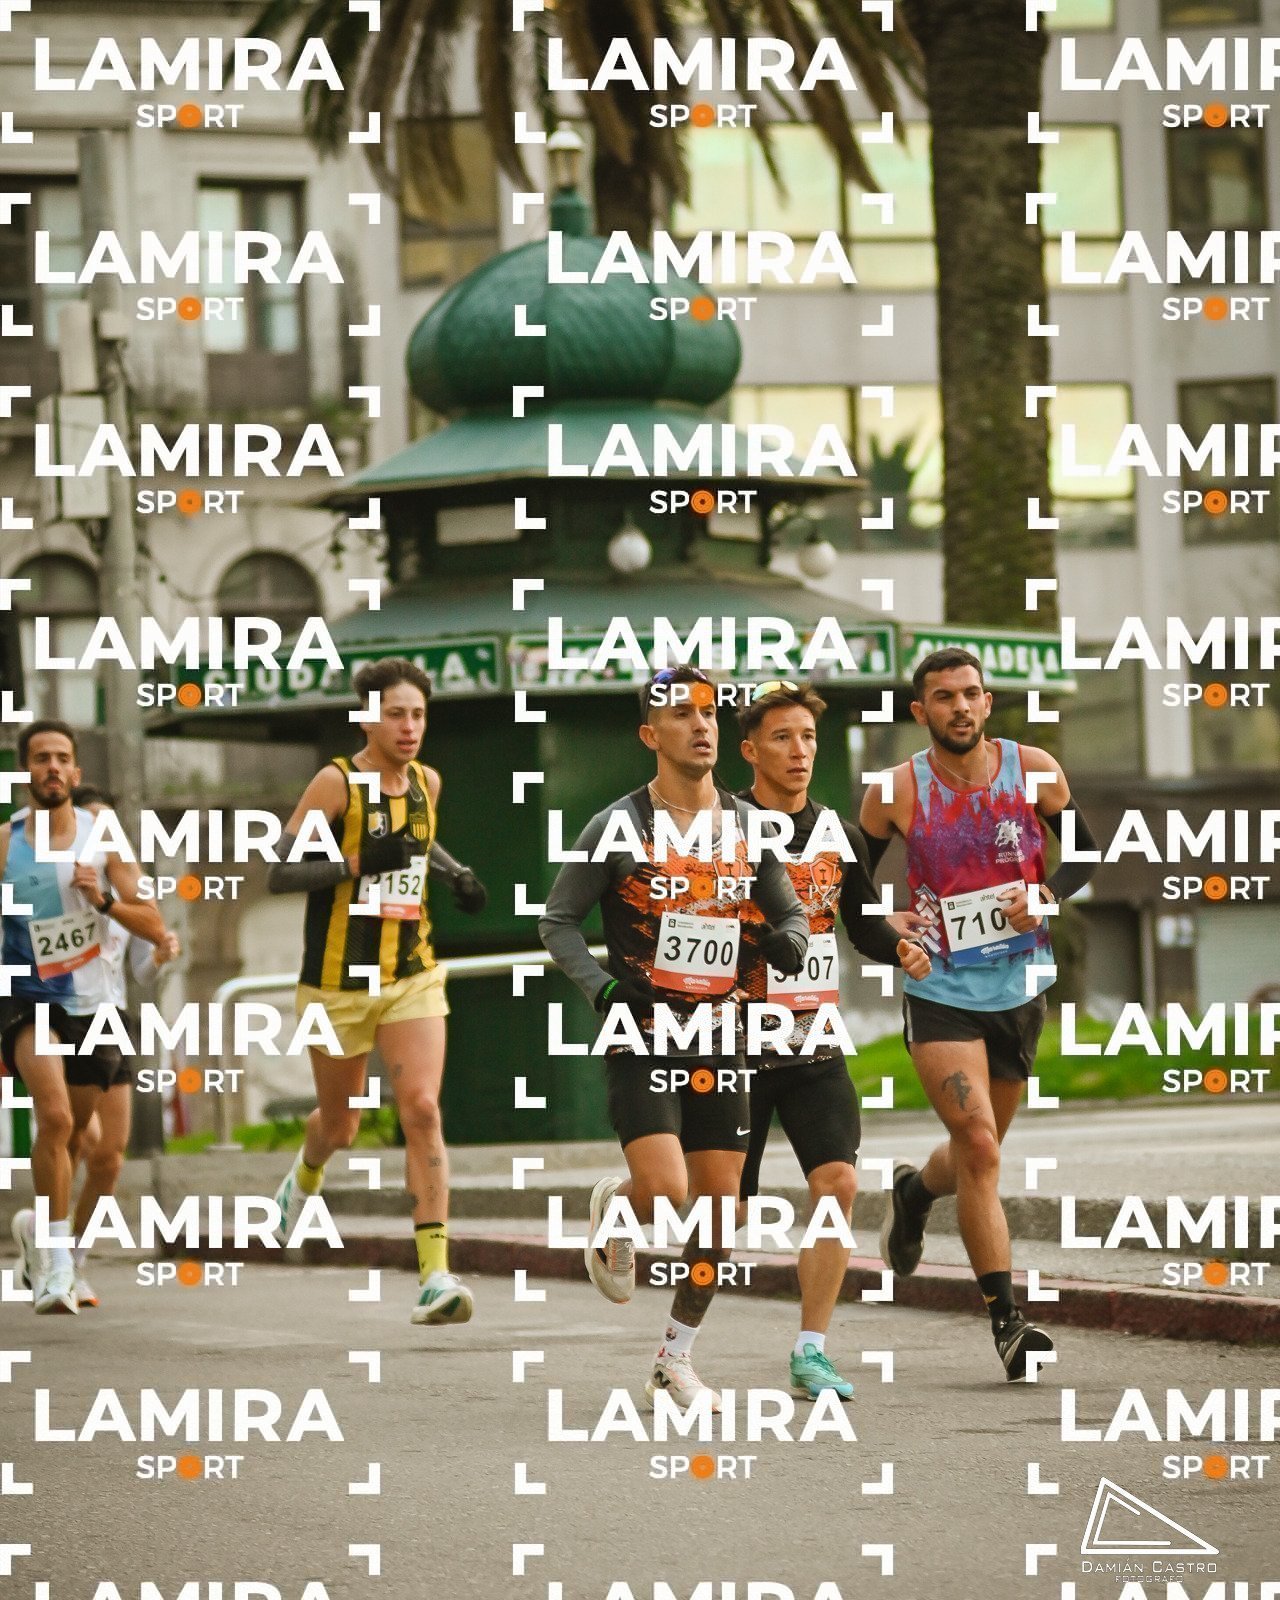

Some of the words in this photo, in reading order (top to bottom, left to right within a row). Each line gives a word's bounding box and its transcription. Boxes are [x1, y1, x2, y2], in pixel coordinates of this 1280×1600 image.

[38, 922, 96, 956] 2467
[663, 935, 734, 967] 3700
[774, 955, 834, 984] 07
